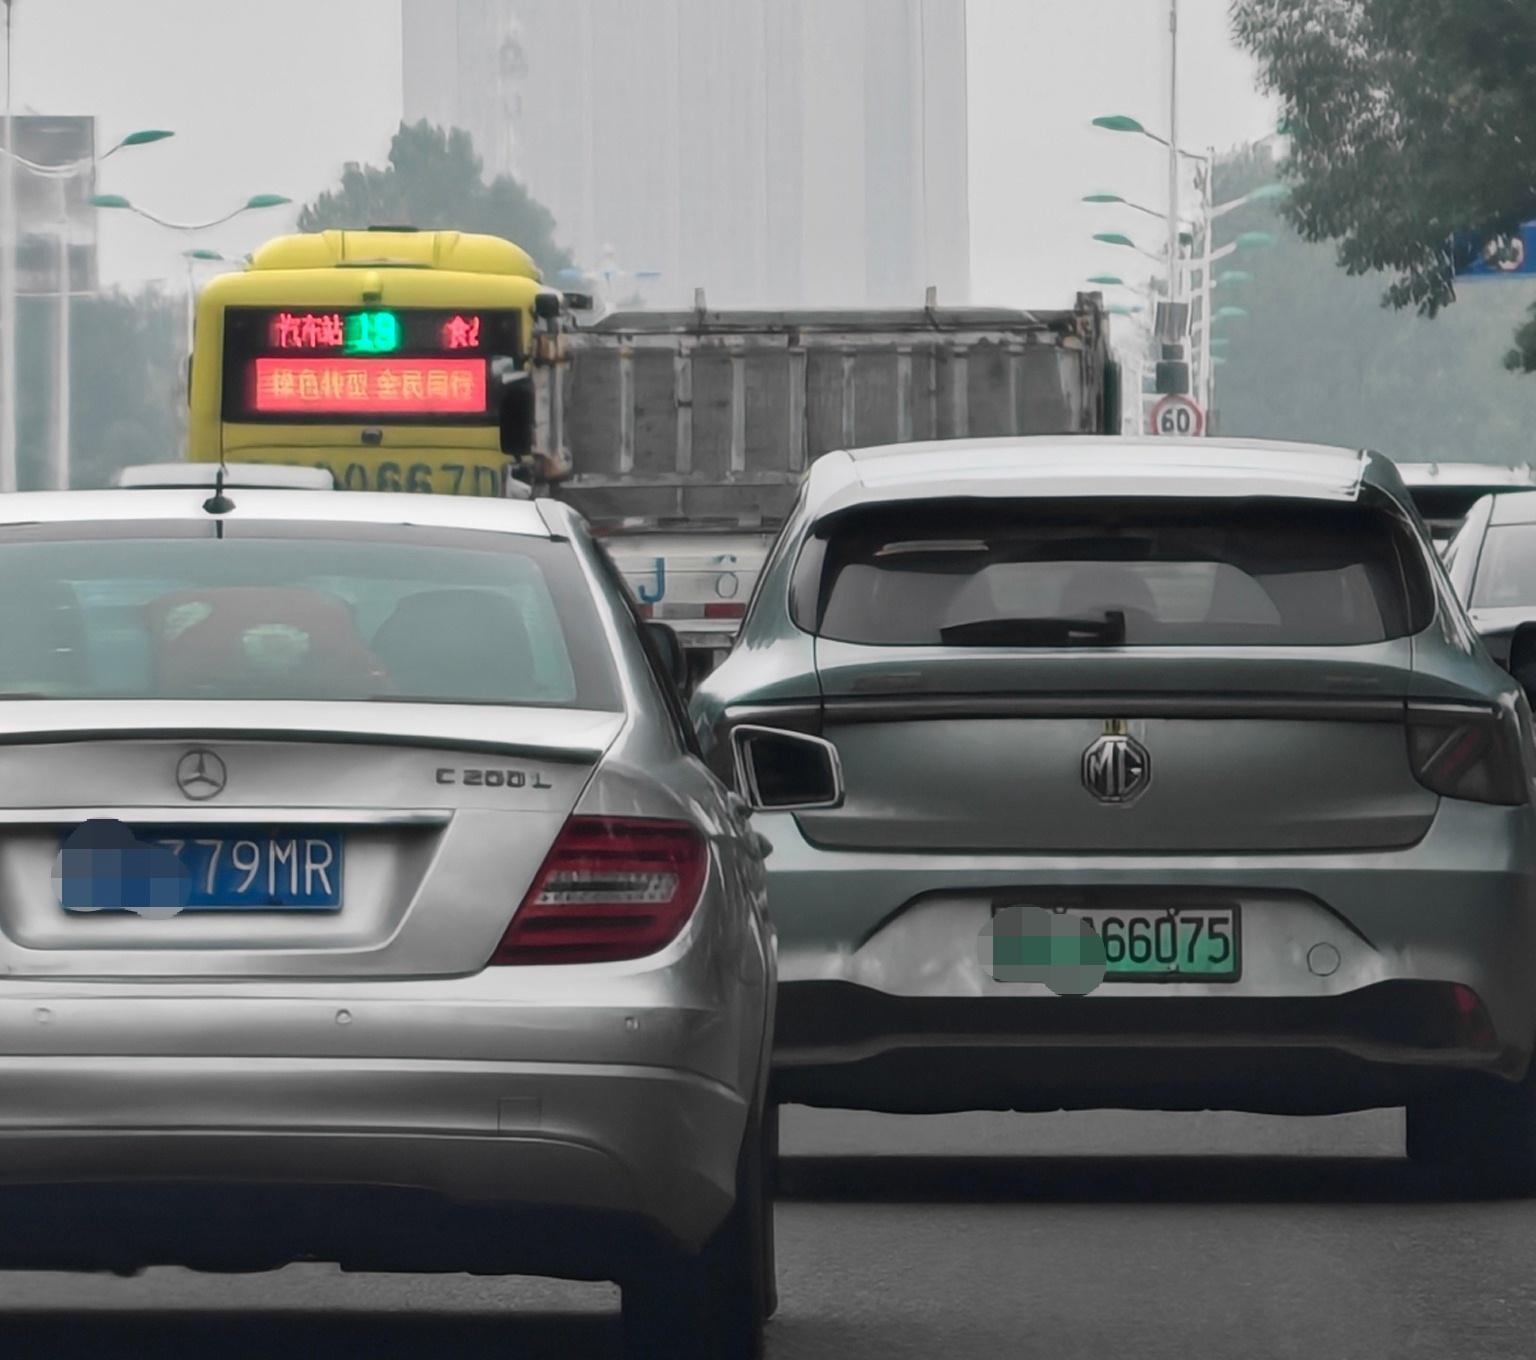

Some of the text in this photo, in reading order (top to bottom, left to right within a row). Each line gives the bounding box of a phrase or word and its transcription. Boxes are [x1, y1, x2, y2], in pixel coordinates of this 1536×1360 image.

[1162, 407, 1190, 433] 60
[435, 767, 456, 785] C
[462, 768, 526, 789] 200
[1082, 916, 1230, 964] 66075
